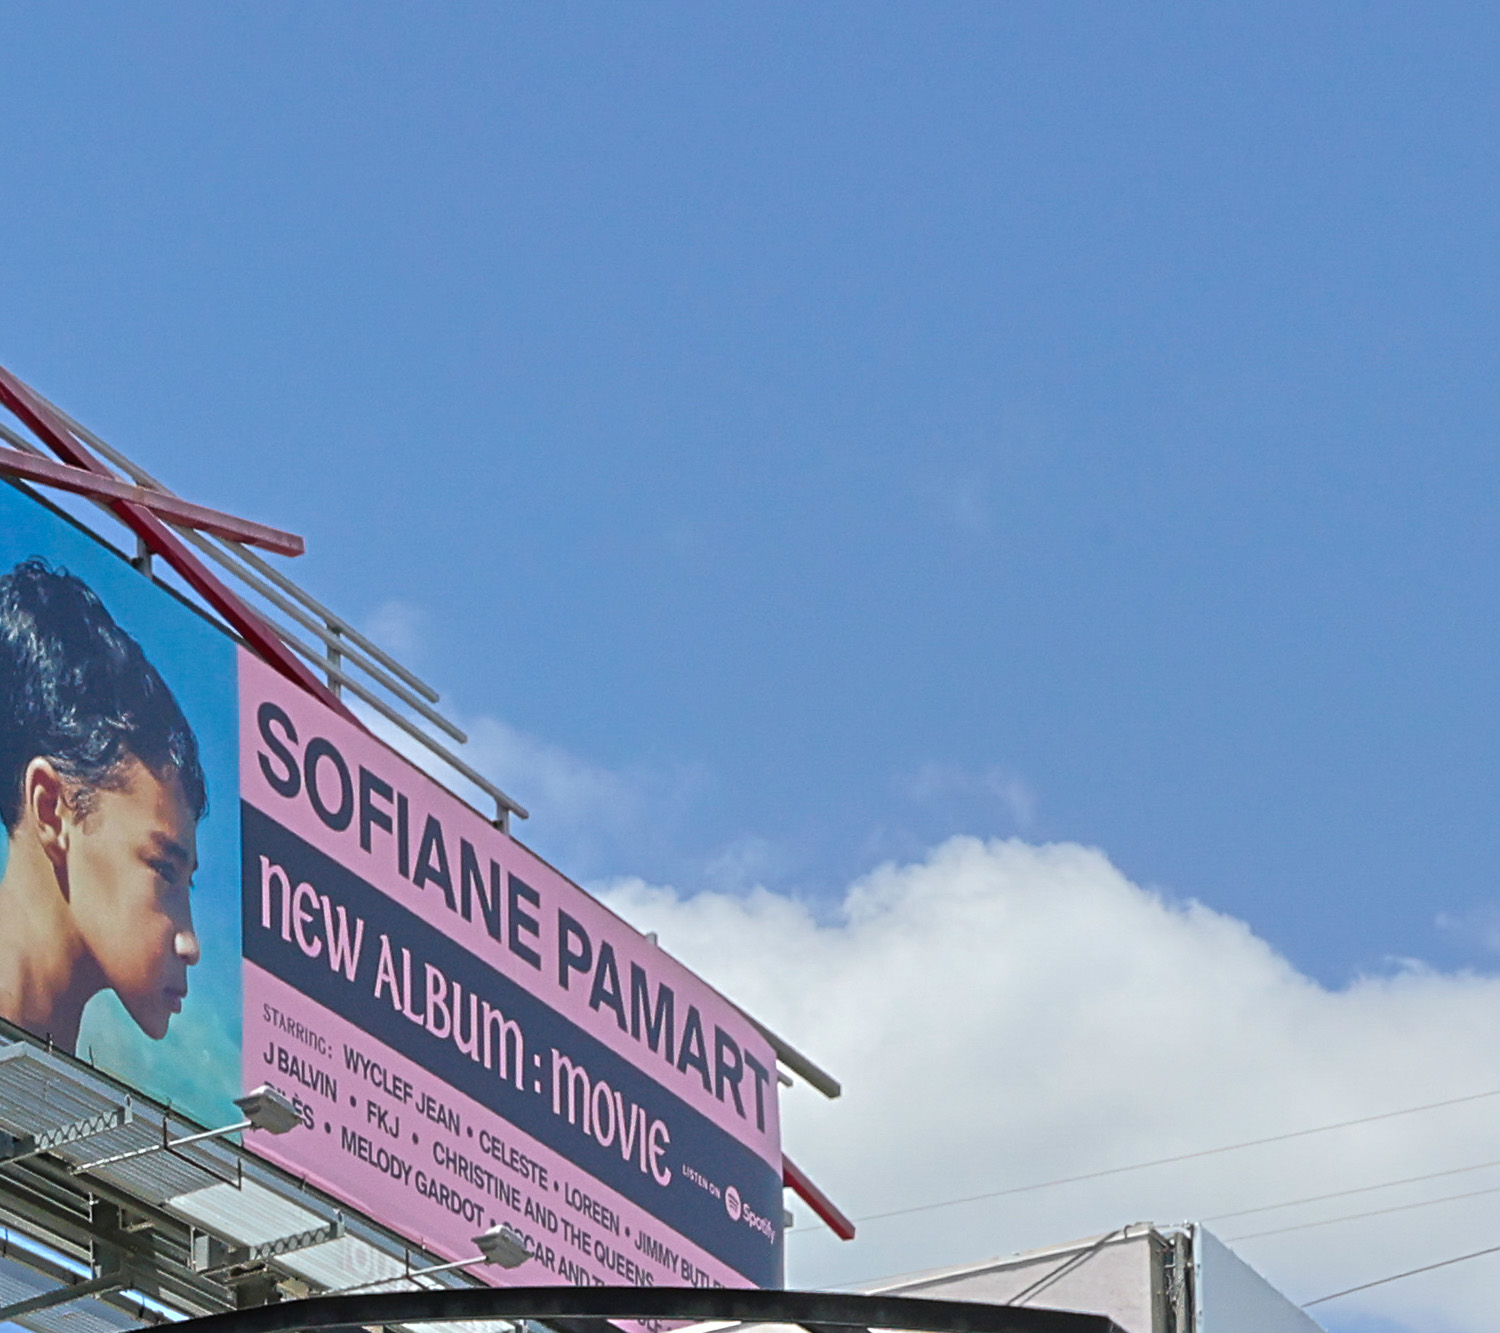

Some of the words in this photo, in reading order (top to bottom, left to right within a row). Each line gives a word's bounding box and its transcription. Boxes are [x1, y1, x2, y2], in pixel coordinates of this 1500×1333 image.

[257, 702, 542, 971] SOFIANE
[559, 908, 770, 1134] PAMART
[263, 1042, 274, 1065] J
[278, 1047, 337, 1103] BALVIN
[367, 1100, 399, 1139] FKJ
[433, 1142, 521, 1211] CHRISTINE
[524, 1198, 558, 1234] AND
[561, 1218, 592, 1256] THE
[341, 1126, 412, 1186] MELODY
[415, 1171, 485, 1228] GARDOT
[343, 1044, 414, 1105] WYCLEF
[416, 1092, 461, 1137] JEAN
[479, 1130, 548, 1192] CELESTE
[565, 1182, 620, 1237] LOREEN
[634, 1230, 680, 1274] JIMMY
[682, 1163, 708, 1190] LISTEN
[742, 1203, 776, 1245] Spotify
